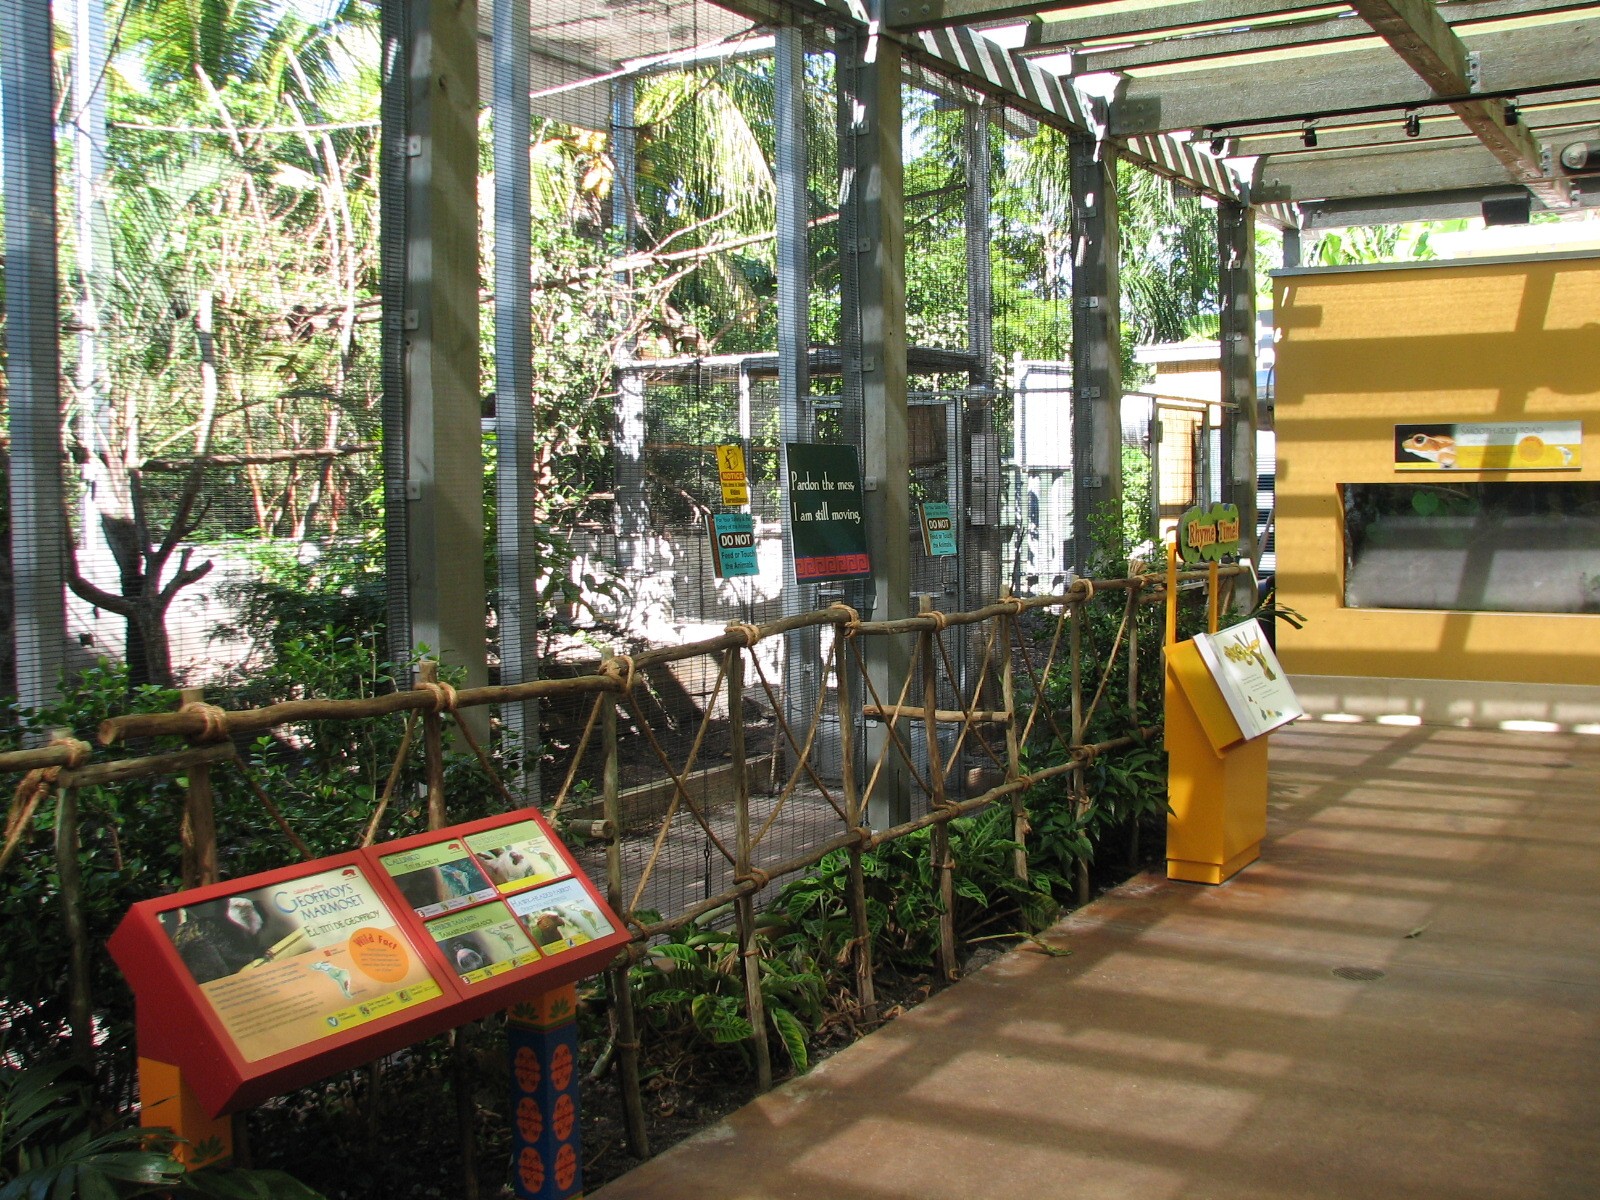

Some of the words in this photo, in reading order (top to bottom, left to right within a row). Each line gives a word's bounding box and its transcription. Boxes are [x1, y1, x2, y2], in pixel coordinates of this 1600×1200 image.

[722, 473, 744, 481] NOTICE
[791, 471, 820, 491] Pardon
[822, 471, 835, 490] the
[793, 502, 798, 521] I
[800, 511, 813, 521] am
[815, 502, 829, 521] still
[929, 520, 938, 529] DO
[938, 520, 949, 529] NOT
[1189, 522, 1215, 548] Rhyme
[1219, 519, 1239, 541] Time!
[721, 535, 733, 547] DO
[735, 534, 751, 546] NOT
[721, 551, 734, 559] Feed
[740, 550, 754, 559] Touch
[274, 884, 354, 914] GEOFFROY'S
[301, 893, 365, 921] MARMOSET
[333, 920, 345, 930] DE
[345, 909, 380, 927] GEOFFROY
[353, 934, 375, 949] Wild
[378, 934, 397, 951] Fact
